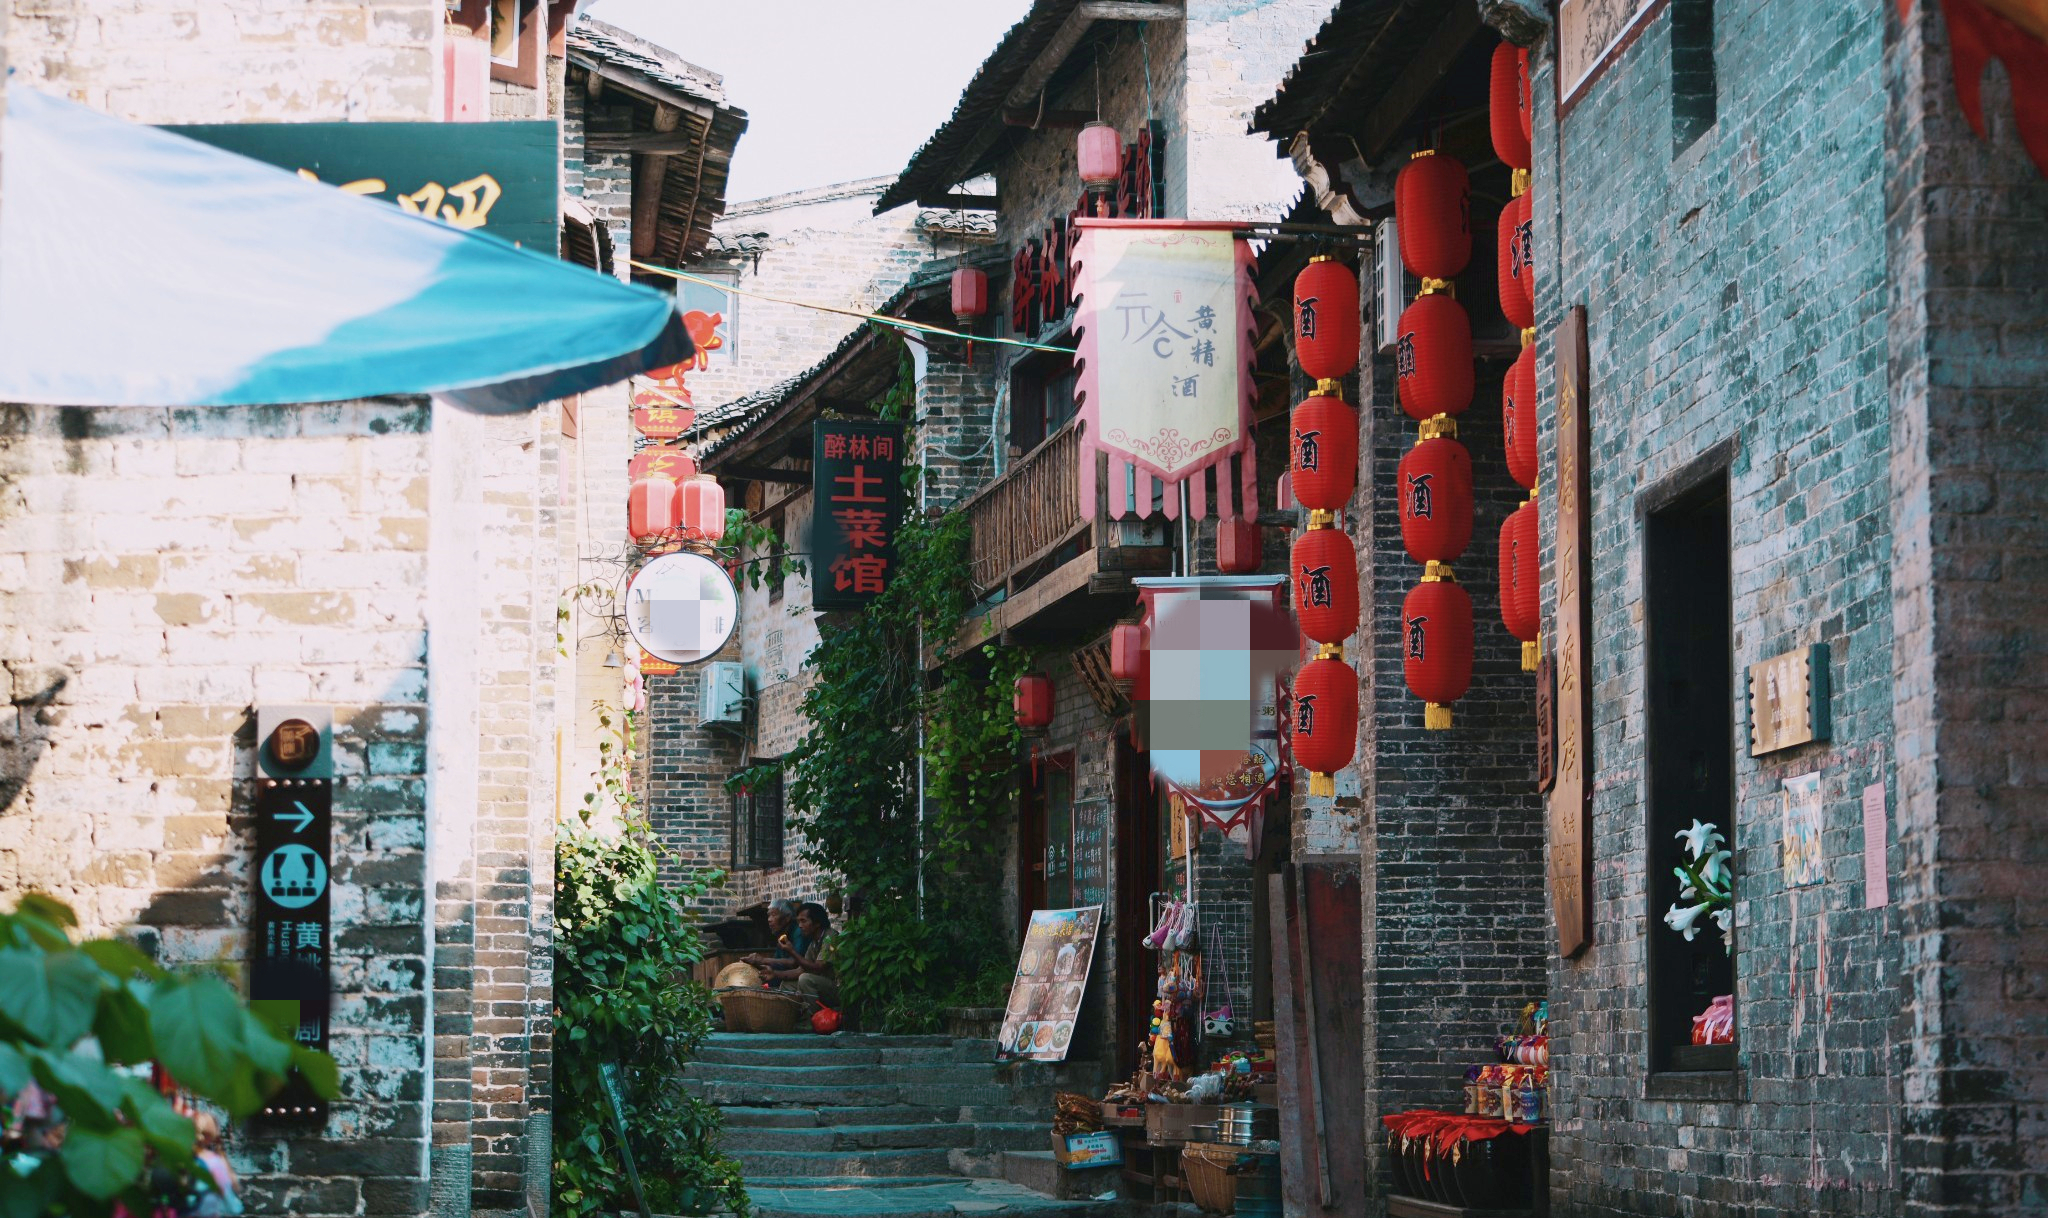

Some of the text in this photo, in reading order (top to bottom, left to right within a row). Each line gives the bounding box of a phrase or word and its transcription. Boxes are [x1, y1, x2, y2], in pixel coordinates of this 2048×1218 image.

[824, 433, 894, 462] 醉林间
[1294, 428, 1322, 474] 酒
[1406, 472, 1434, 521] 酒
[828, 464, 888, 594] 土菜馆
[1301, 563, 1332, 611] 酒
